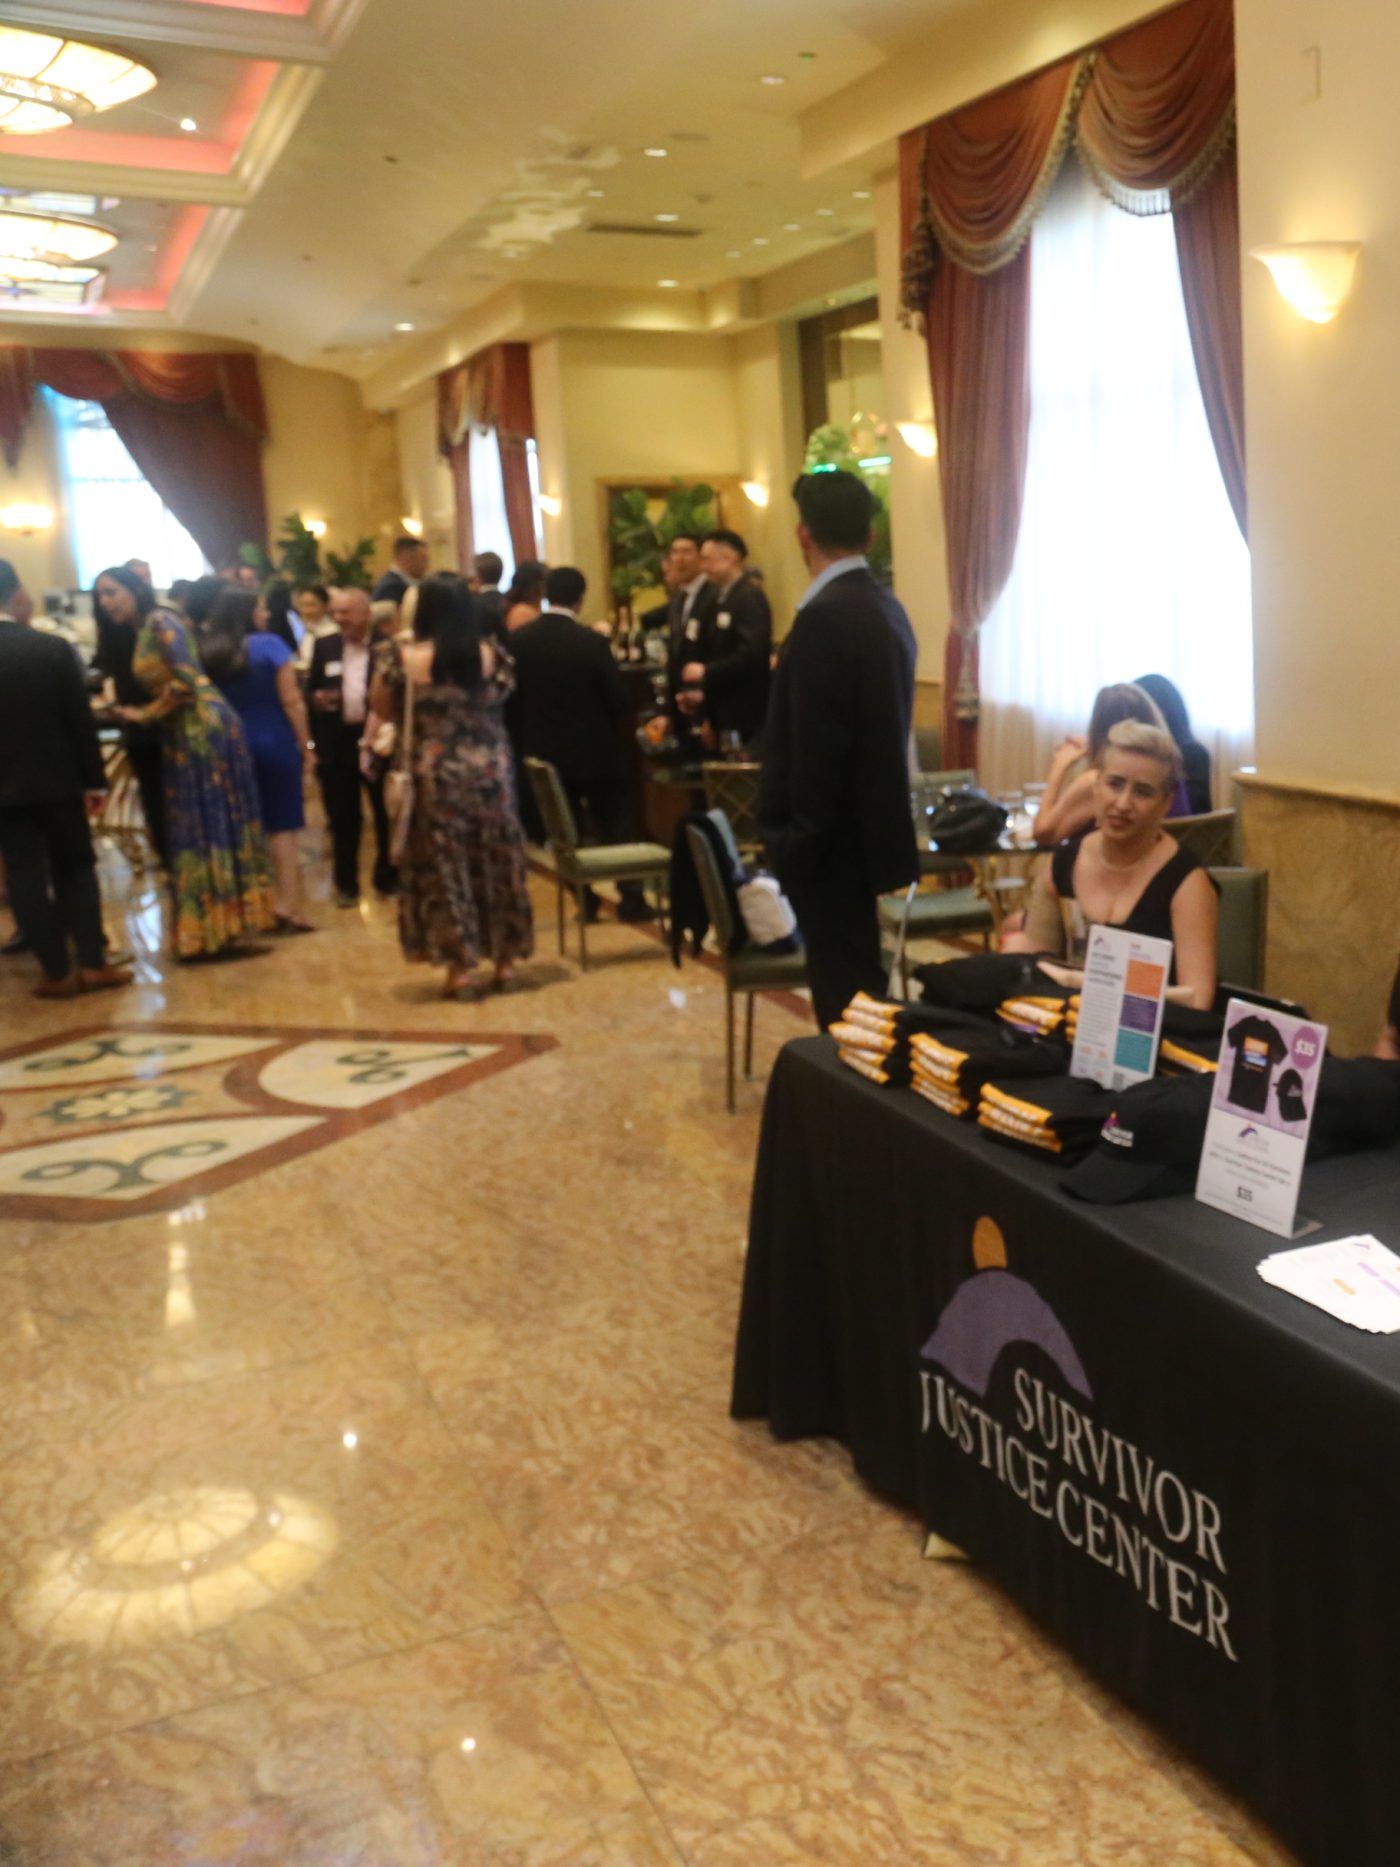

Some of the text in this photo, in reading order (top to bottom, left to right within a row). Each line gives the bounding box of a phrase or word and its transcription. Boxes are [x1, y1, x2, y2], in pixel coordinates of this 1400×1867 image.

[919, 1370, 1239, 1662] JUSTICE CENTER
[1014, 1367, 1228, 1575] SURVIVOR
